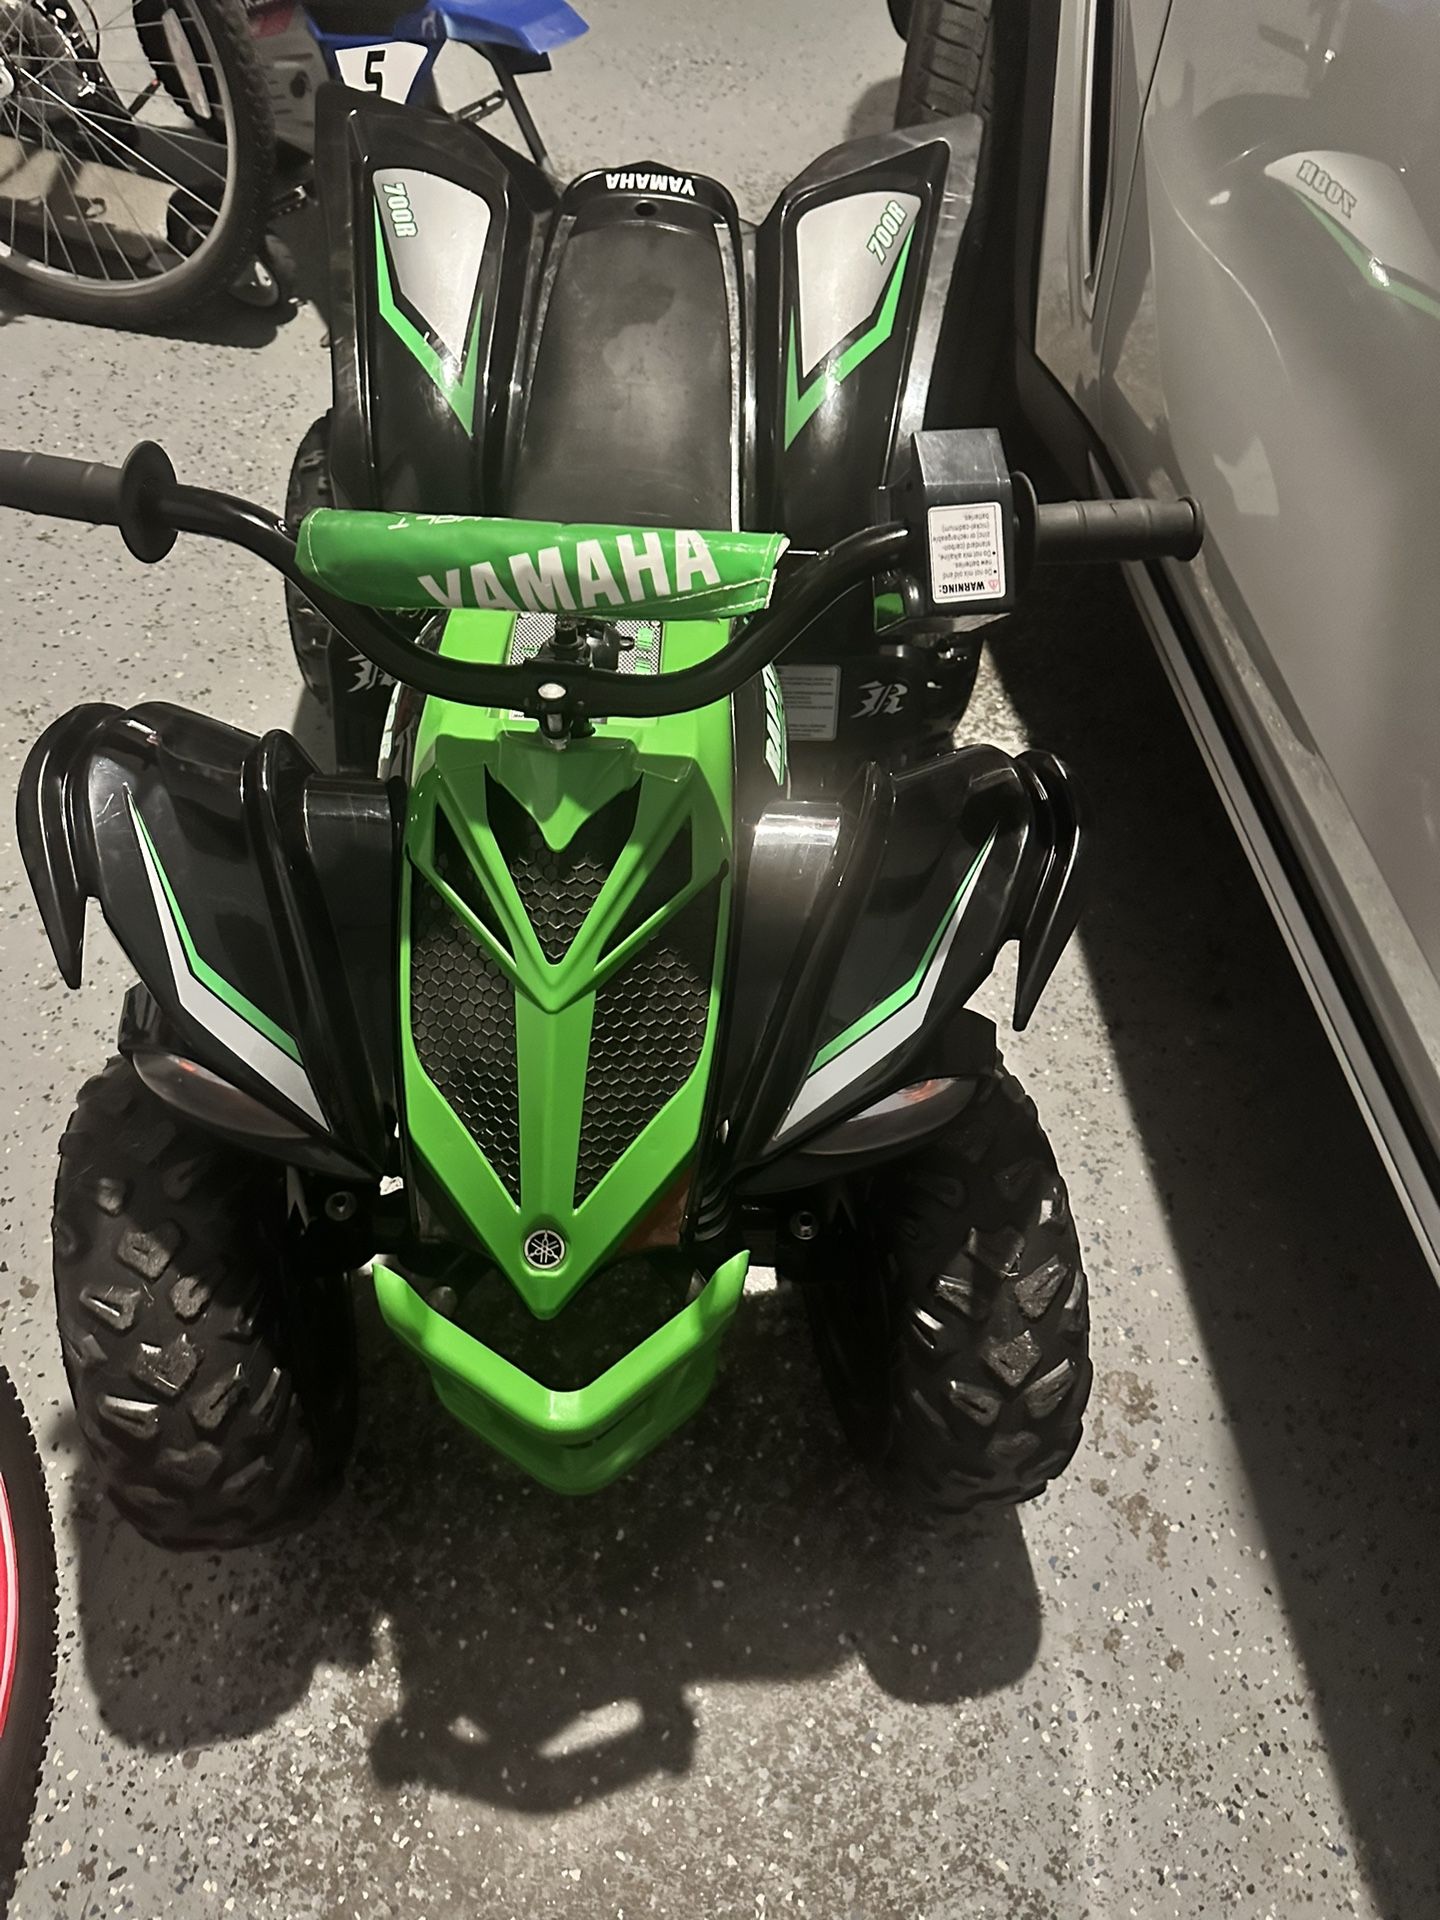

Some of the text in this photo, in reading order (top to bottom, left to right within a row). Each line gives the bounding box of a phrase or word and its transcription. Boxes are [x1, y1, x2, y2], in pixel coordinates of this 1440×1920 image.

[364, 50, 386, 95] 5
[382, 182, 418, 238] 700R
[605, 173, 696, 197] YAMAHA
[866, 199, 907, 266] 700R
[418, 530, 721, 611] YAMAHA
[939, 581, 985, 594] WARNING:
